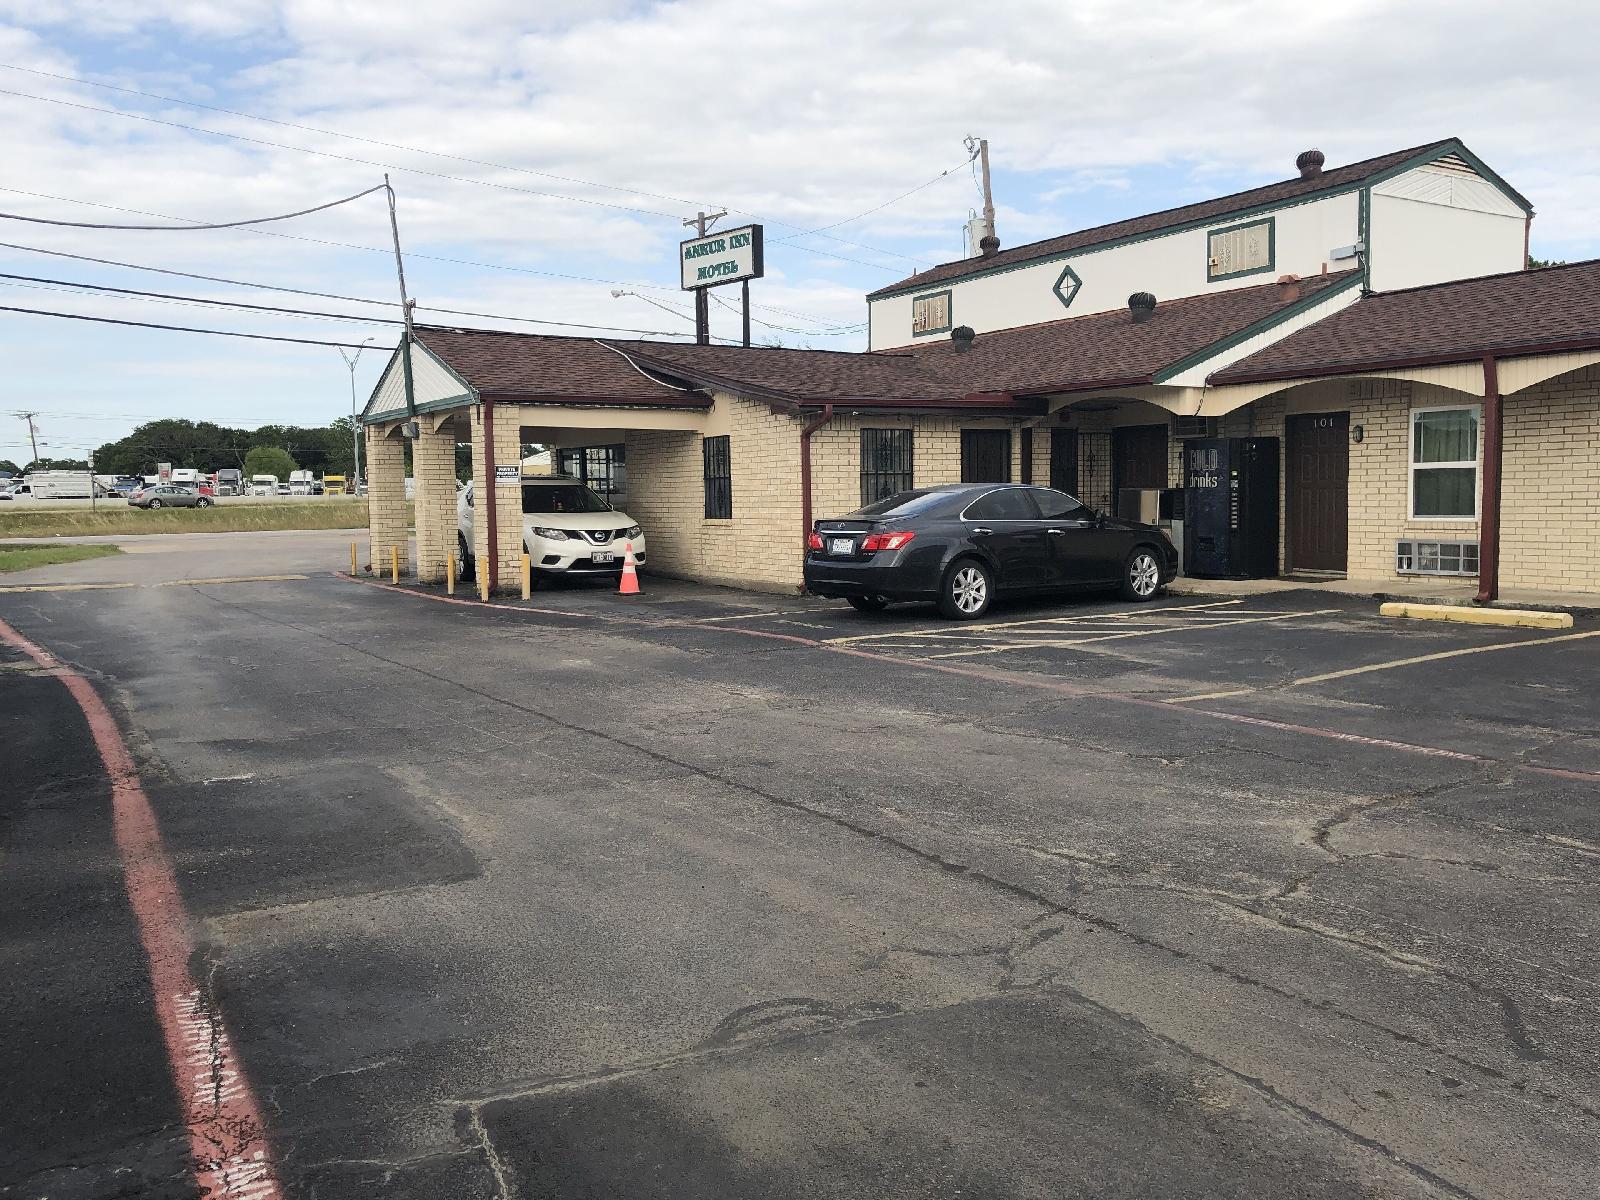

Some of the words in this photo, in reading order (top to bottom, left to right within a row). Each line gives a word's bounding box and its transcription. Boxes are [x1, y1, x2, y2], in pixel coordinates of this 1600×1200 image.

[684, 239, 726, 260] ANKUR
[729, 232, 751, 250] INN
[1314, 418, 1333, 428] 101
[1189, 472, 1218, 488] drinks
